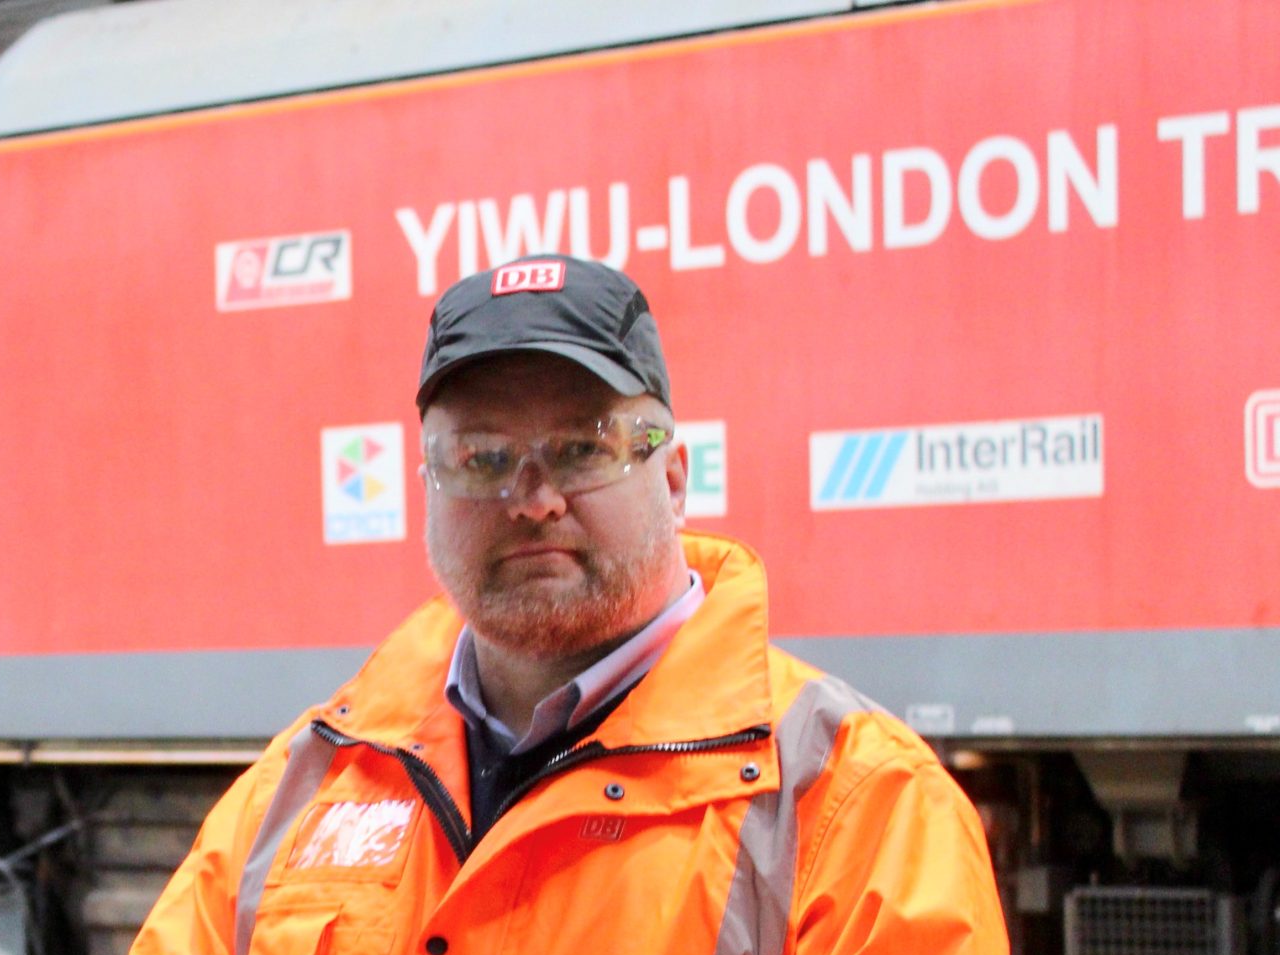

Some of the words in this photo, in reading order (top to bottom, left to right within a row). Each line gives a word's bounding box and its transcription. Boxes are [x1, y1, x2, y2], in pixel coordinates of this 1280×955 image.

[395, 123, 1118, 295] YIWU-LONDON
[272, 236, 343, 277] CR
[500, 267, 555, 288] DB
[691, 442, 721, 494] E
[917, 420, 1099, 472] InterRail
[581, 816, 620, 839] DB
